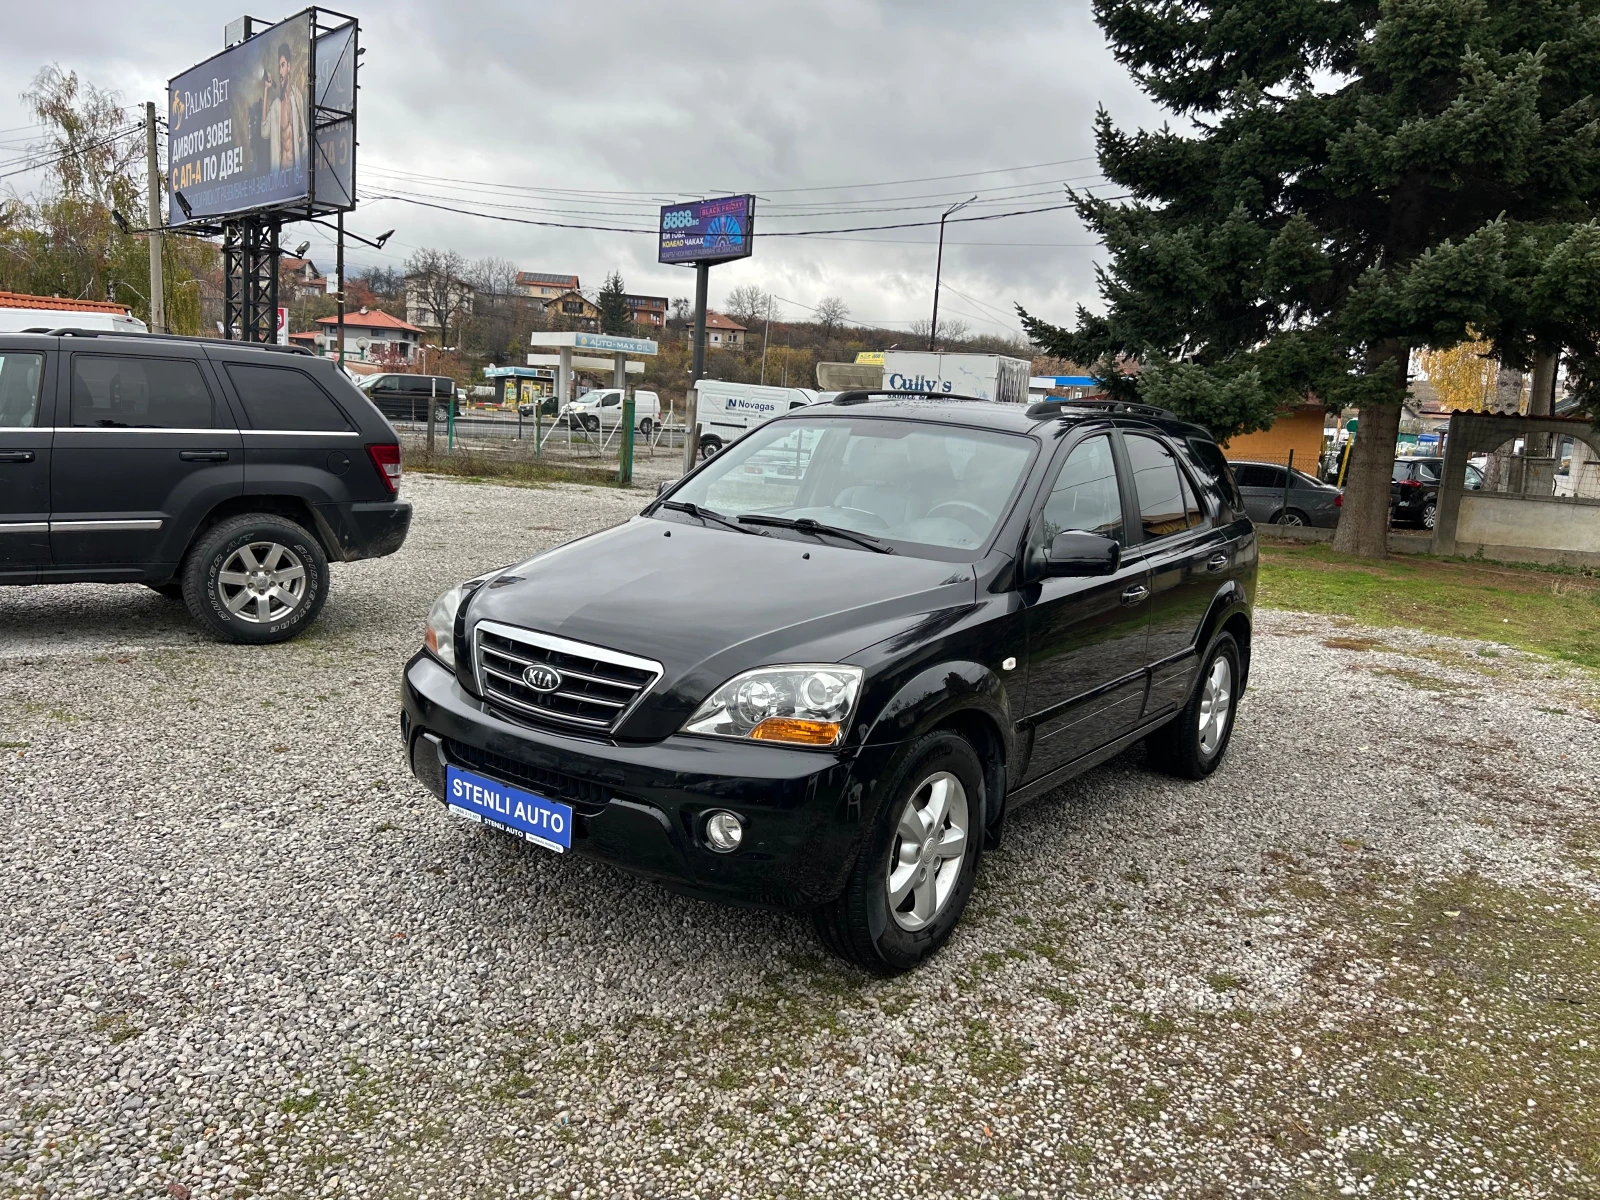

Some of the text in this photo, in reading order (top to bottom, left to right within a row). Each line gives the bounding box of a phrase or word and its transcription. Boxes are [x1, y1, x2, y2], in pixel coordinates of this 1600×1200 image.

[172, 118, 232, 164] ДИВОТО ЗОВЕ!
[172, 146, 243, 191] С АП-А ПО ДВЕ!
[702, 206, 721, 216] BLACK
[662, 237, 704, 248] КОЛЕЛО ЧАКАХ
[590, 339, 650, 352] AUTO-MAX OIL
[738, 399, 775, 412] Novagas
[527, 668, 553, 688] KIA
[452, 778, 510, 815] STENLI
[513, 801, 564, 833] AUTO
[484, 817, 524, 838] STENLI AUTO
